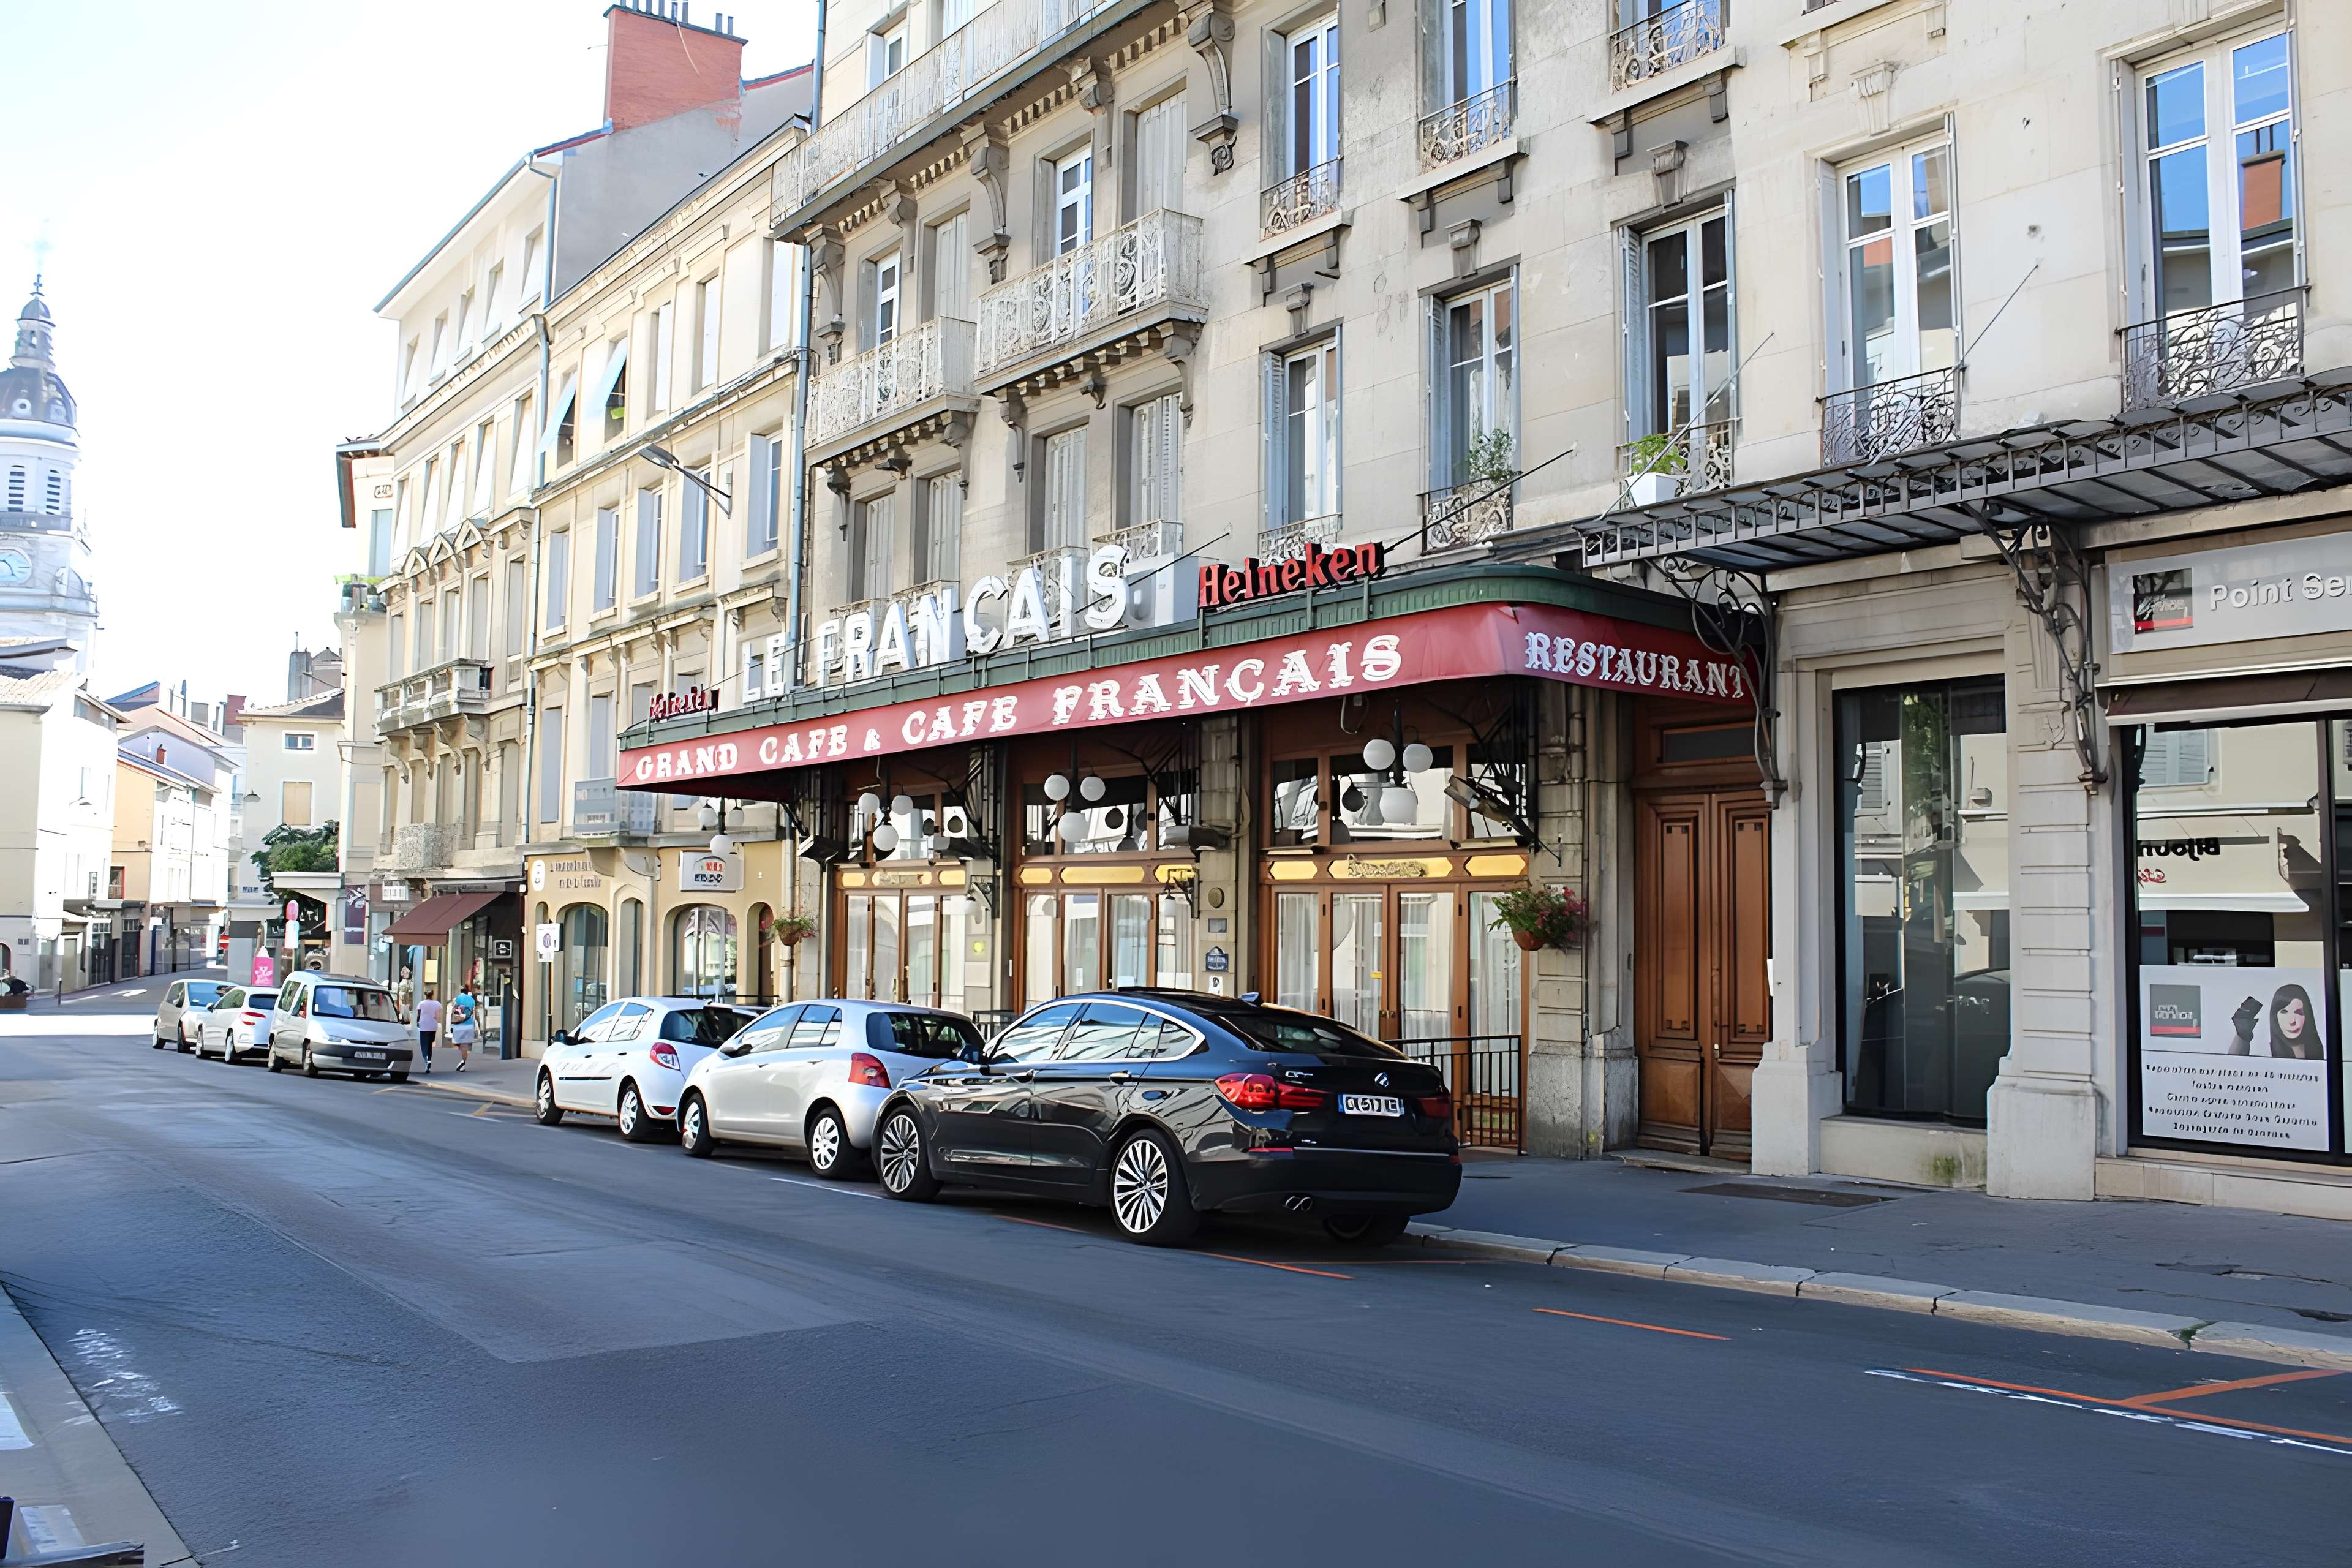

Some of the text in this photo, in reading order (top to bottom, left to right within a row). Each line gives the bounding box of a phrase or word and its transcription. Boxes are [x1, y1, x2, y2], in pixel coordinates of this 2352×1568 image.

[1199, 542, 1382, 608] Heineken
[2210, 578, 2293, 611] Point
[742, 633, 787, 703] LE
[1524, 631, 1745, 699] RESTAURANT
[635, 742, 739, 780] GRAND
[1052, 635, 1403, 725] FRANÇAIS
